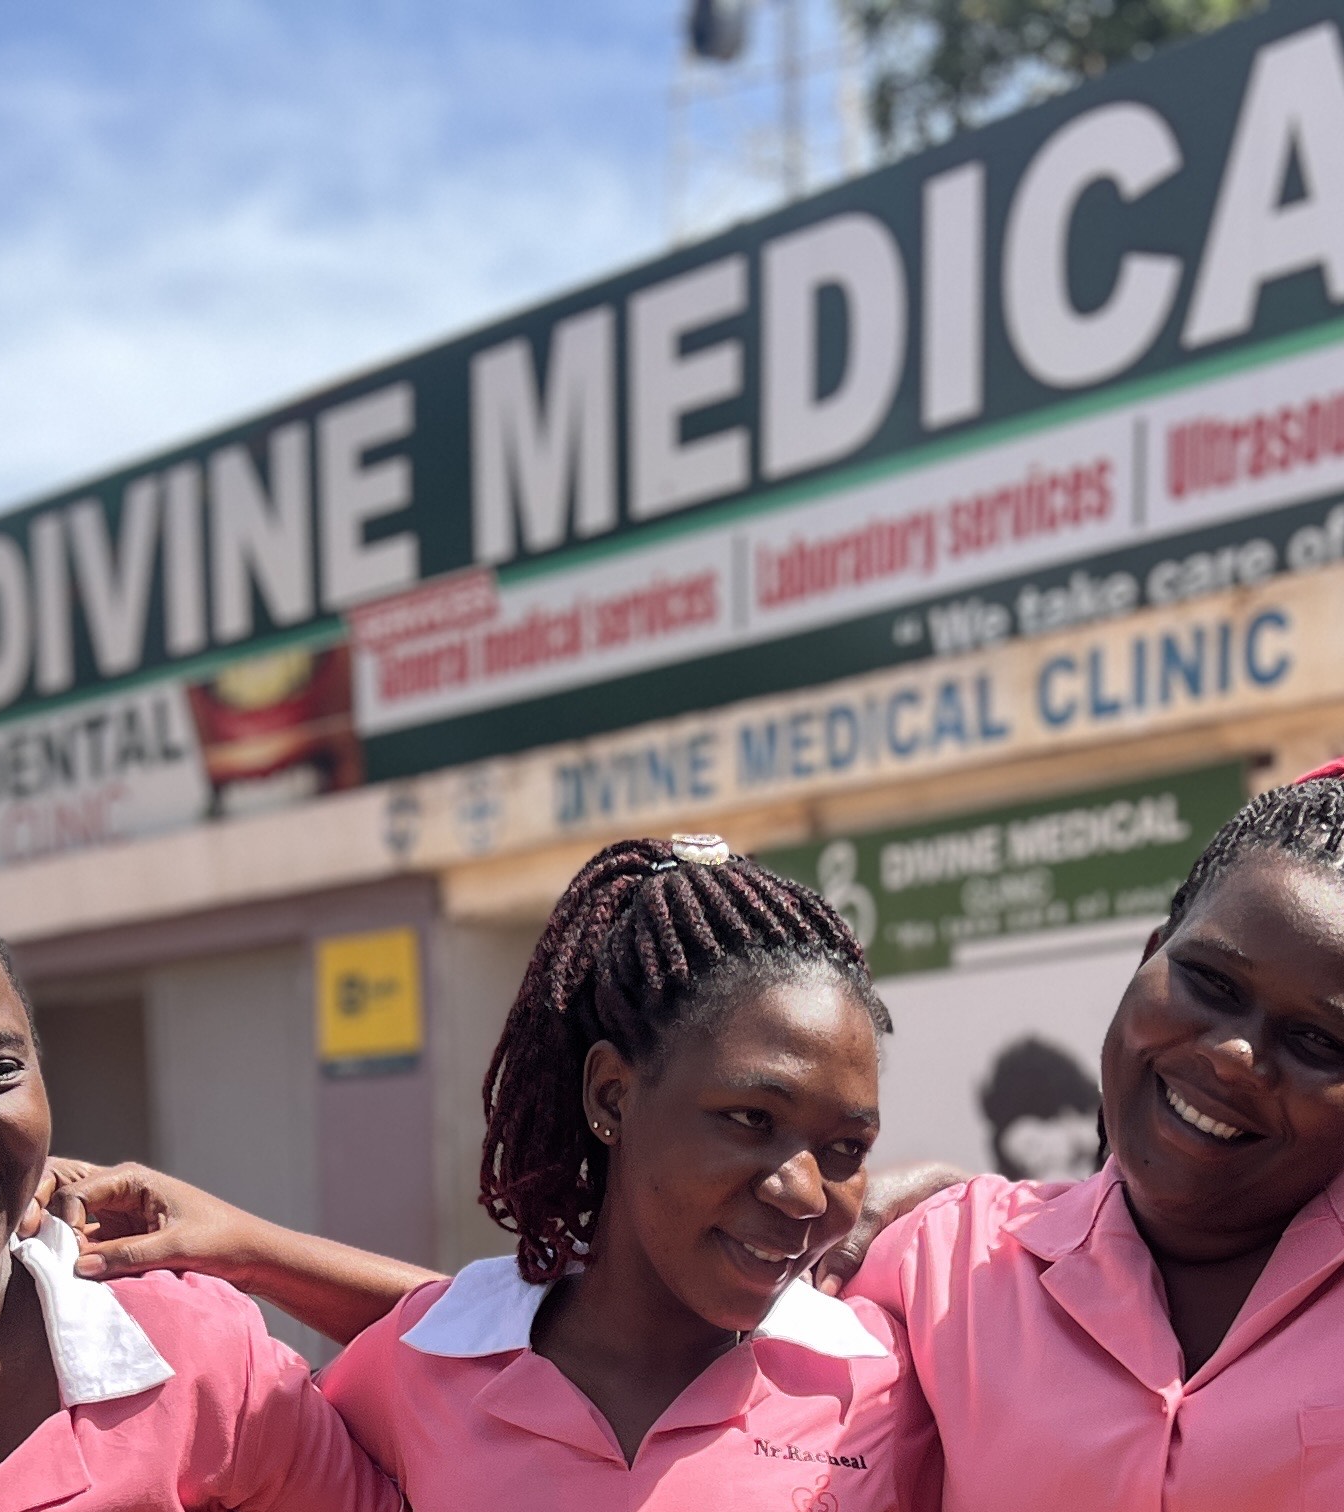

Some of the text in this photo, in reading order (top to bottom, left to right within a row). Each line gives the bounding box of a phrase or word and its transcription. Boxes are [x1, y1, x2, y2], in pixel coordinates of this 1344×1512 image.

[755, 457, 1116, 611] Laboratory services
[595, 568, 720, 650] services
[1017, 571, 1138, 639] take
[1146, 537, 1277, 611] care
[739, 671, 1012, 788] MEDICAL
[1035, 608, 1294, 728] CLINIC
[879, 792, 1193, 894] DIVINE MEDICAL
[753, 1437, 869, 1471] Nr.Racheal
